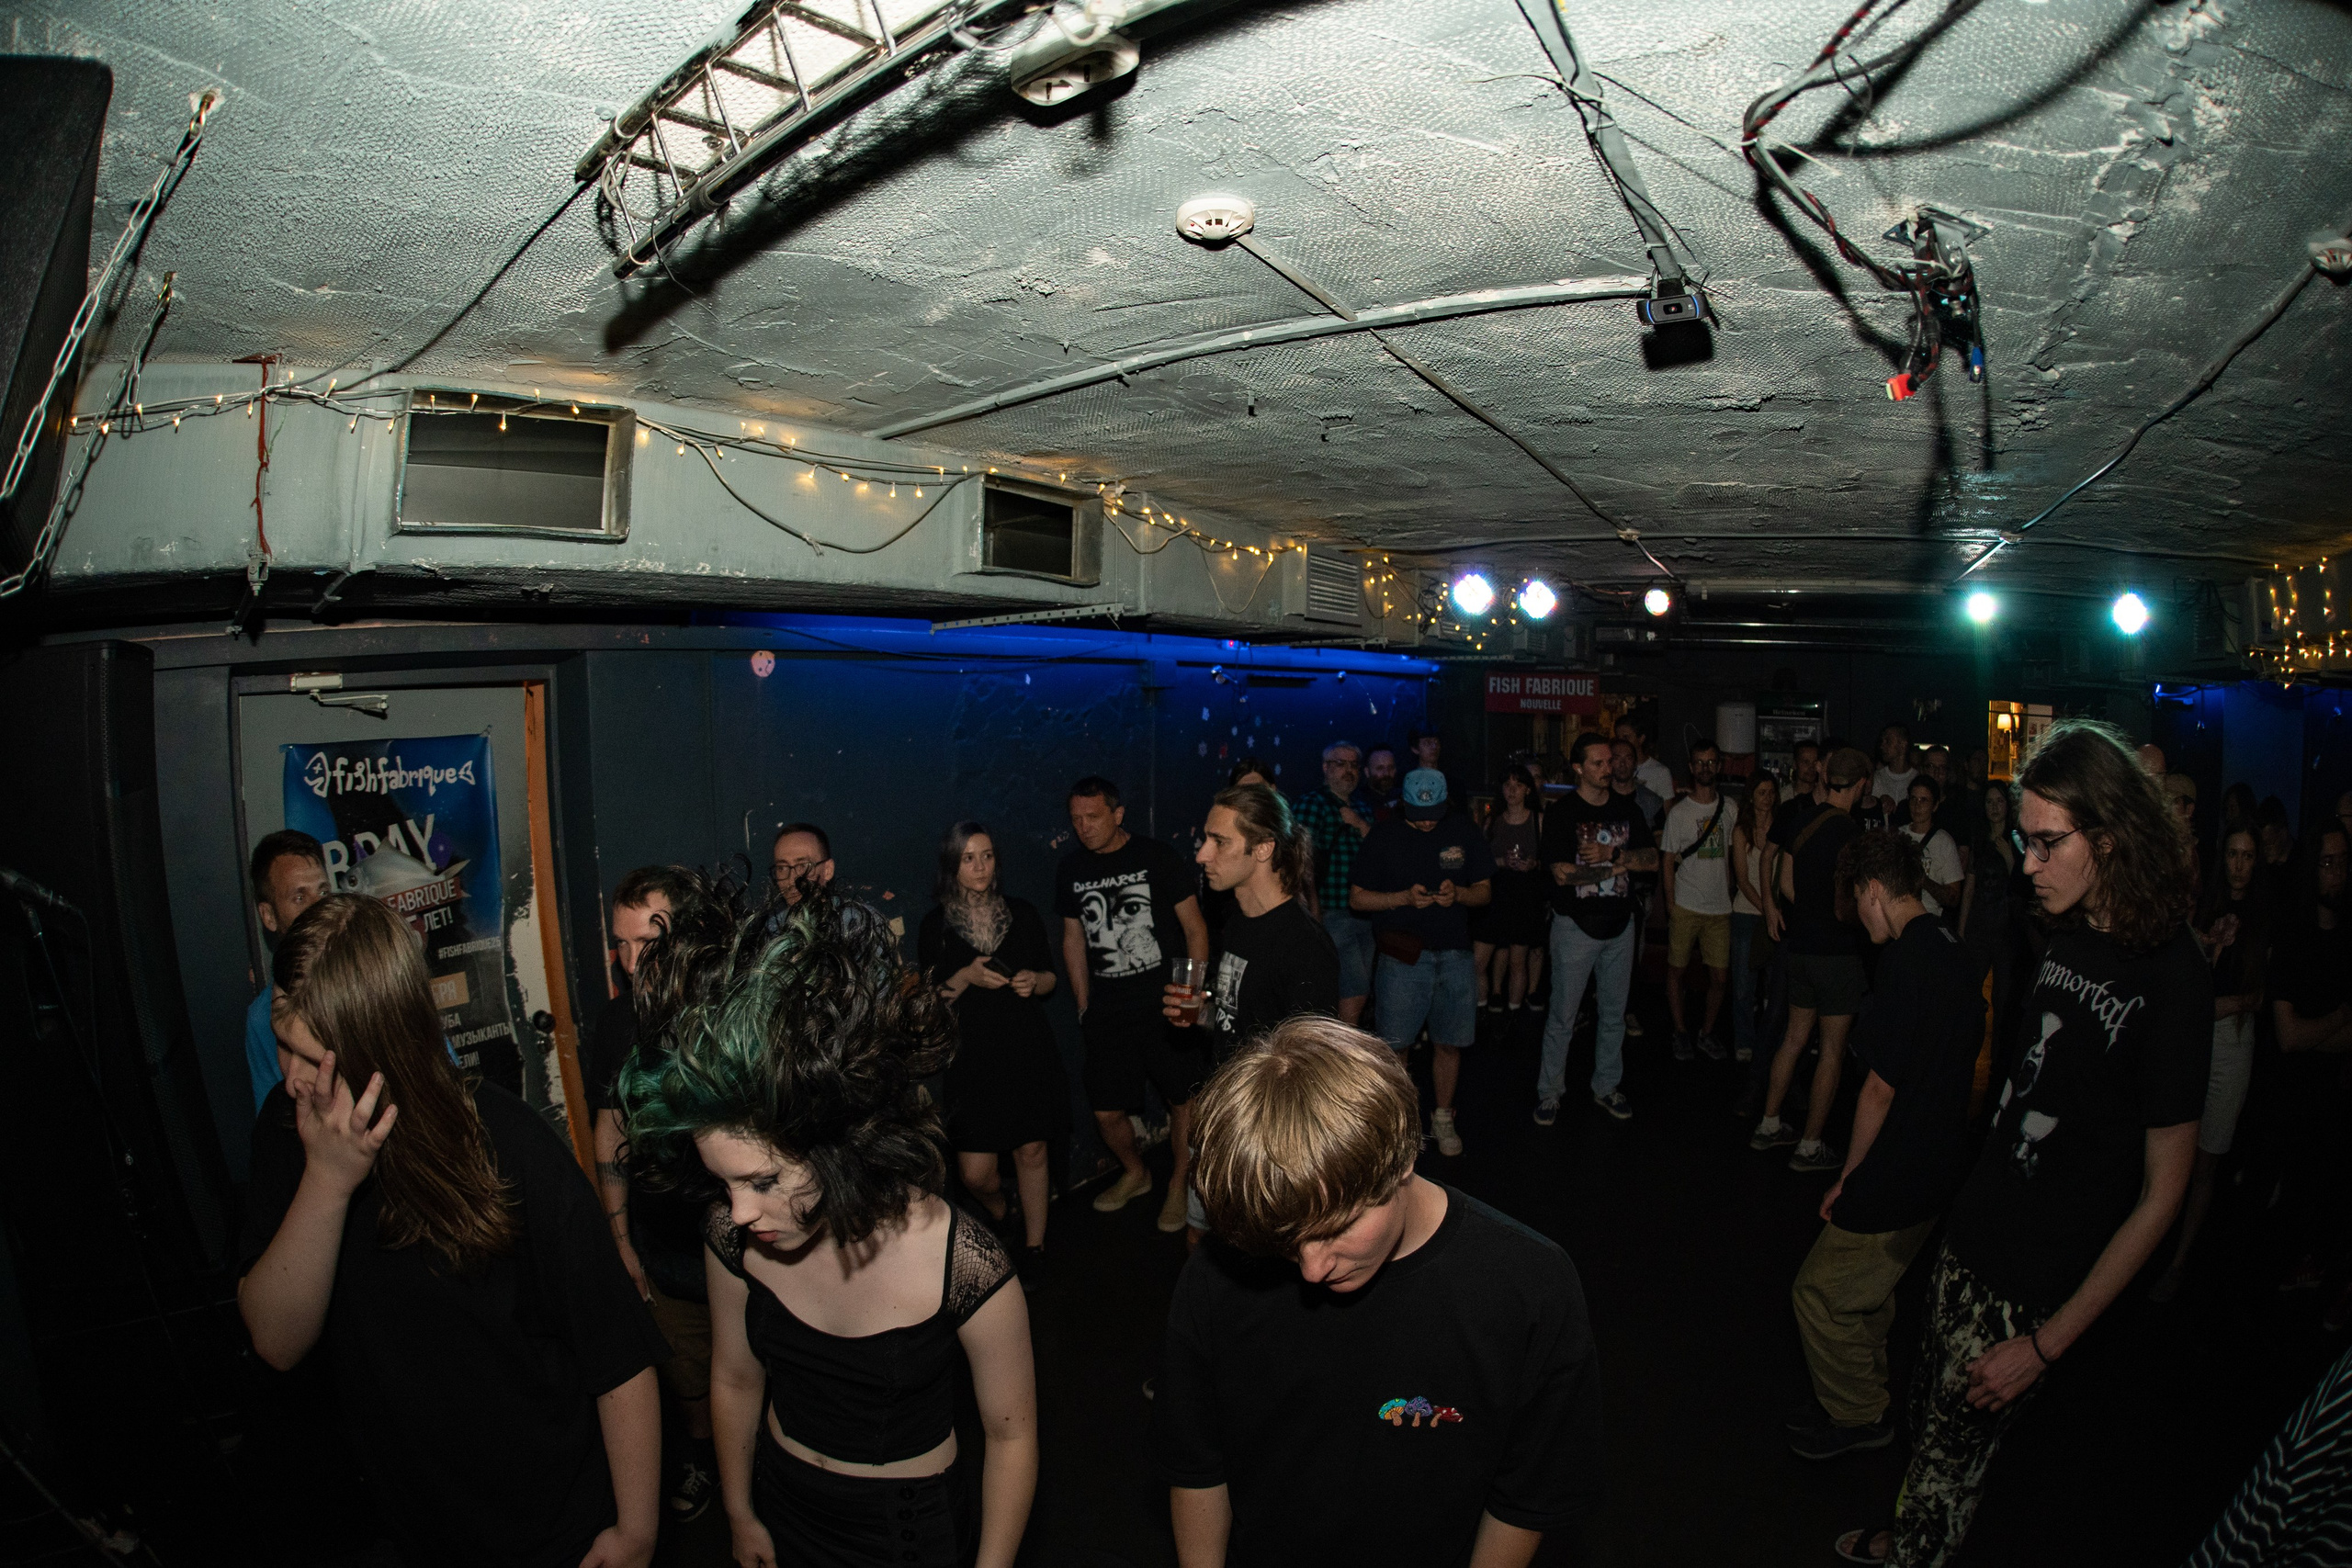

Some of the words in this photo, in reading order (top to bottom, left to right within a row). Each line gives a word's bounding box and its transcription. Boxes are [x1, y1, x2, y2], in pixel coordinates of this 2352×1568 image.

[1489, 676, 1521, 694] FISH
[1525, 678, 1594, 696] FABRIQUE
[1521, 698, 1562, 710] NOUVELLE
[1073, 869, 1148, 894] DISCHARGE
[387, 877, 458, 913] FABRIQUE
